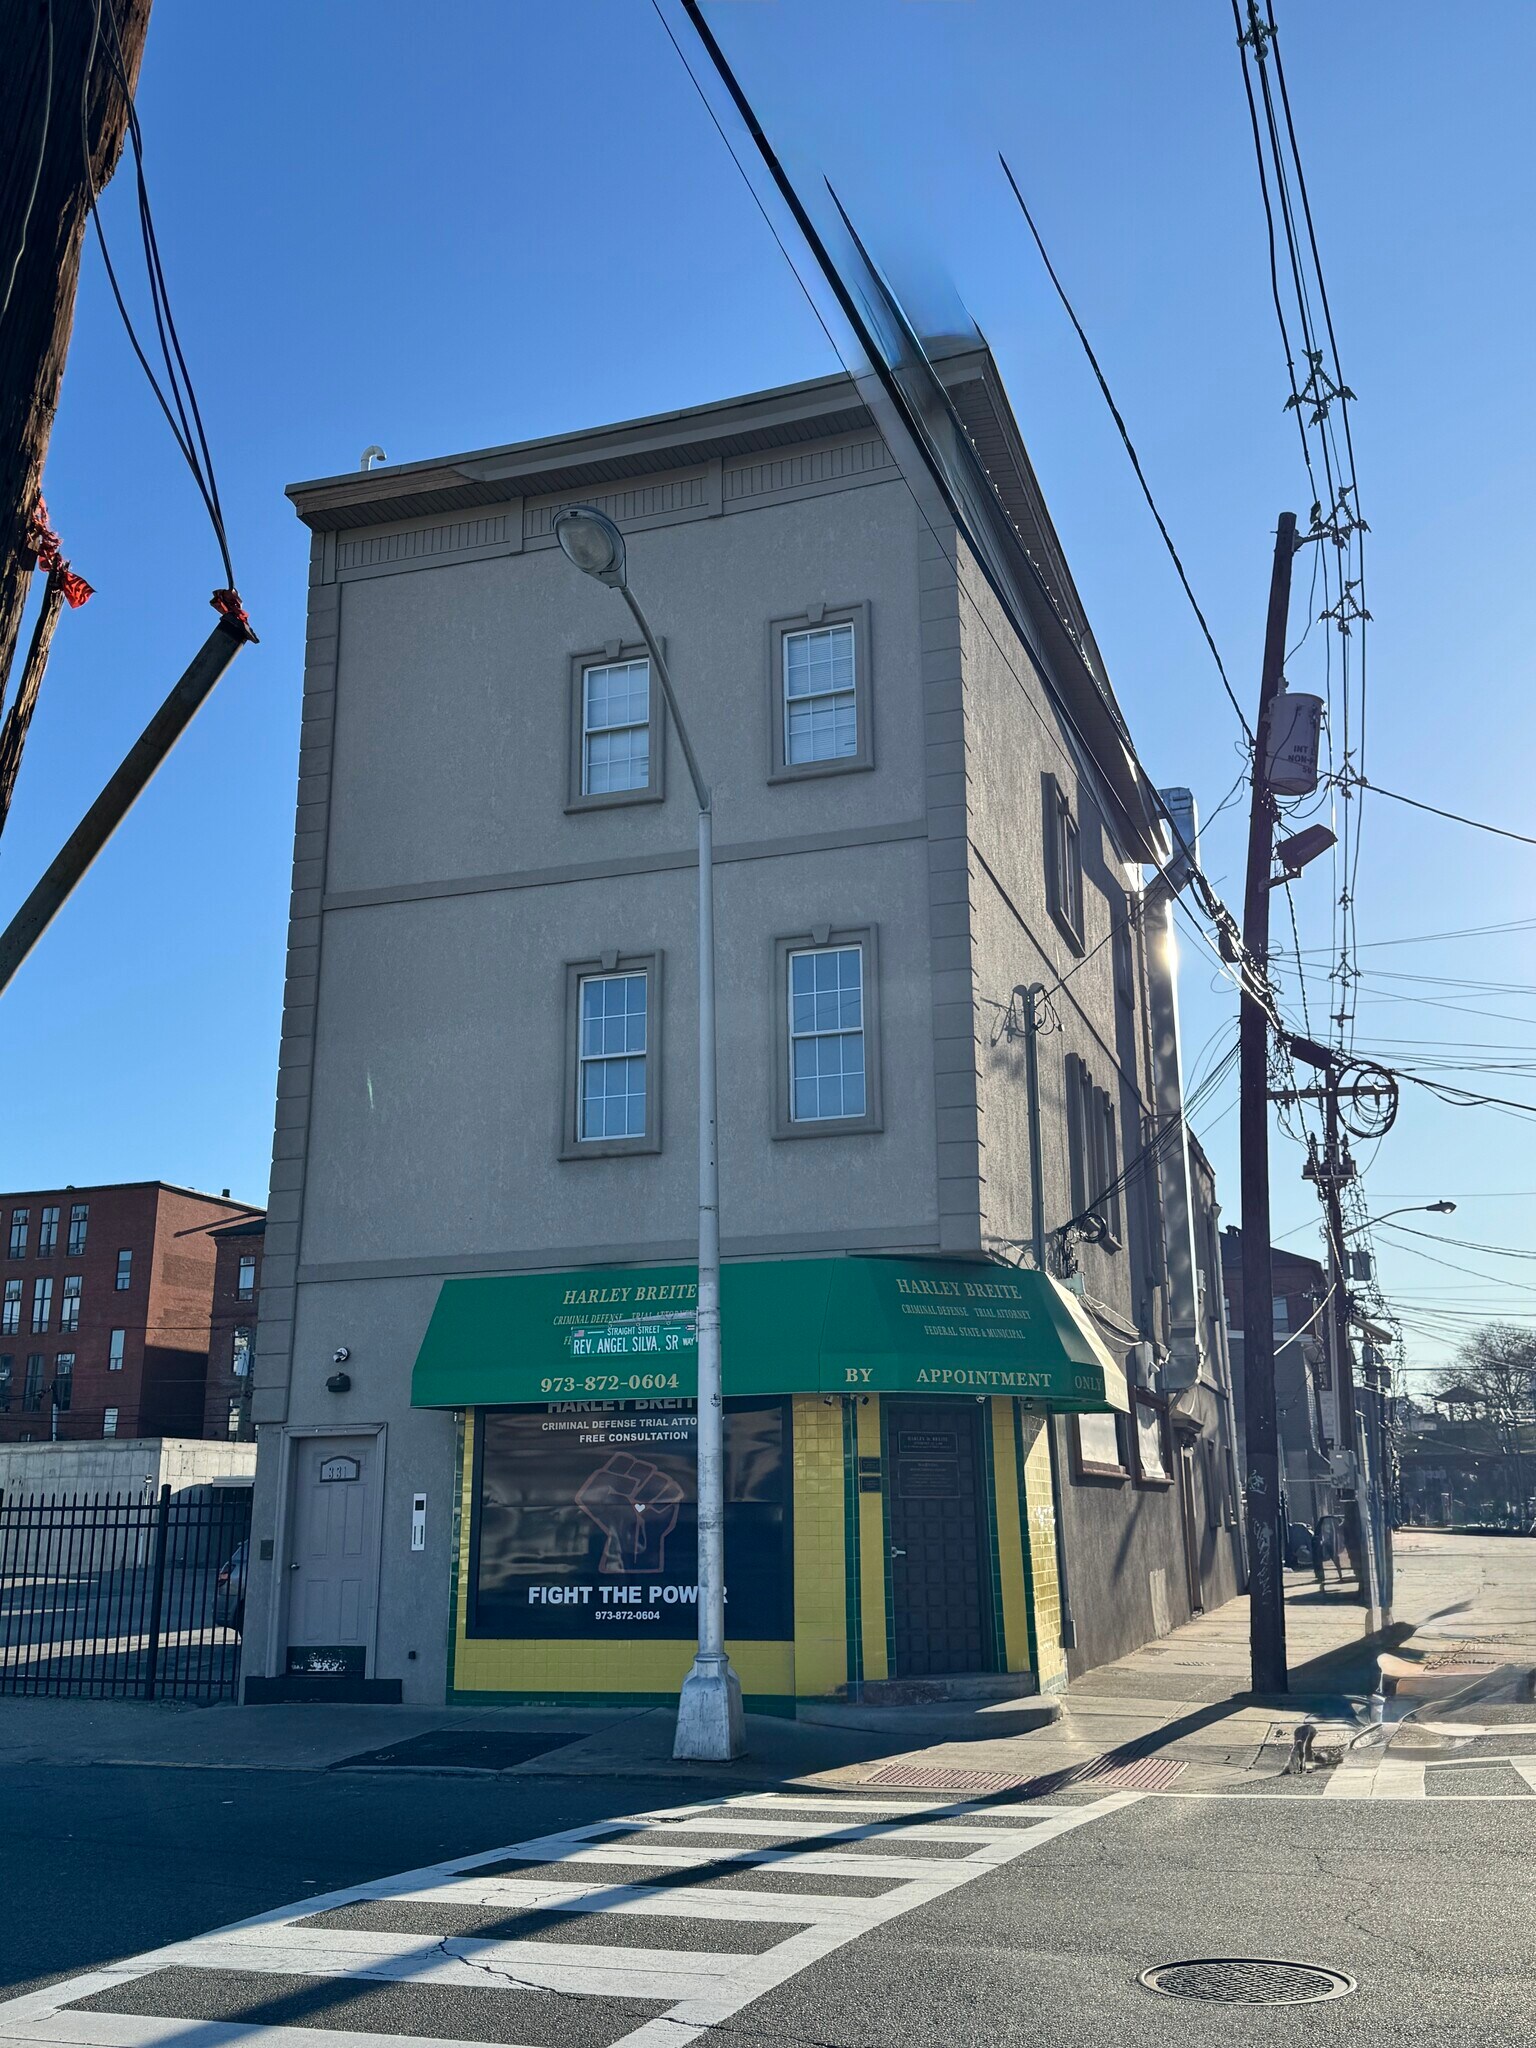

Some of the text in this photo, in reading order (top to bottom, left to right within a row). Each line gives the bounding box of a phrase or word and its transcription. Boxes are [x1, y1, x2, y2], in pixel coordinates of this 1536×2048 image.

[1293, 745, 1308, 753] INT
[562, 1284, 697, 1305] HARLEY BREITE
[896, 1279, 1022, 1299] HARLEY BREITE
[553, 1314, 589, 1325] CRIMINAL
[590, 1313, 623, 1323] DEFENSE
[901, 1304, 1031, 1320] CRIMINAL DEFENSE TRIAL ATTORNEY
[607, 1325, 660, 1336] STRAIGHT STREET
[924, 1325, 958, 1336] FEDERAL
[959, 1327, 982, 1337] STATE
[987, 1328, 1026, 1339] MUNICIPAL
[573, 1338, 595, 1355] REV.
[597, 1337, 629, 1353] ANGEL
[632, 1335, 661, 1352] SILVA,
[665, 1335, 679, 1351] SR
[682, 1337, 695, 1346] WAY
[540, 1373, 679, 1392] 973-872-0604
[845, 1368, 1102, 1391] BY APPOINTMENT ONLY
[635, 1398, 694, 1410] BREIT
[541, 1420, 589, 1431] CRIMINAL
[592, 1419, 637, 1429] DEFENSE
[639, 1418, 669, 1427] TRIAL
[579, 1431, 688, 1443] FREE CONSULTATION
[528, 1585, 728, 1604] FIGHT THE POW
[595, 1611, 660, 1620] 973-872-0604
